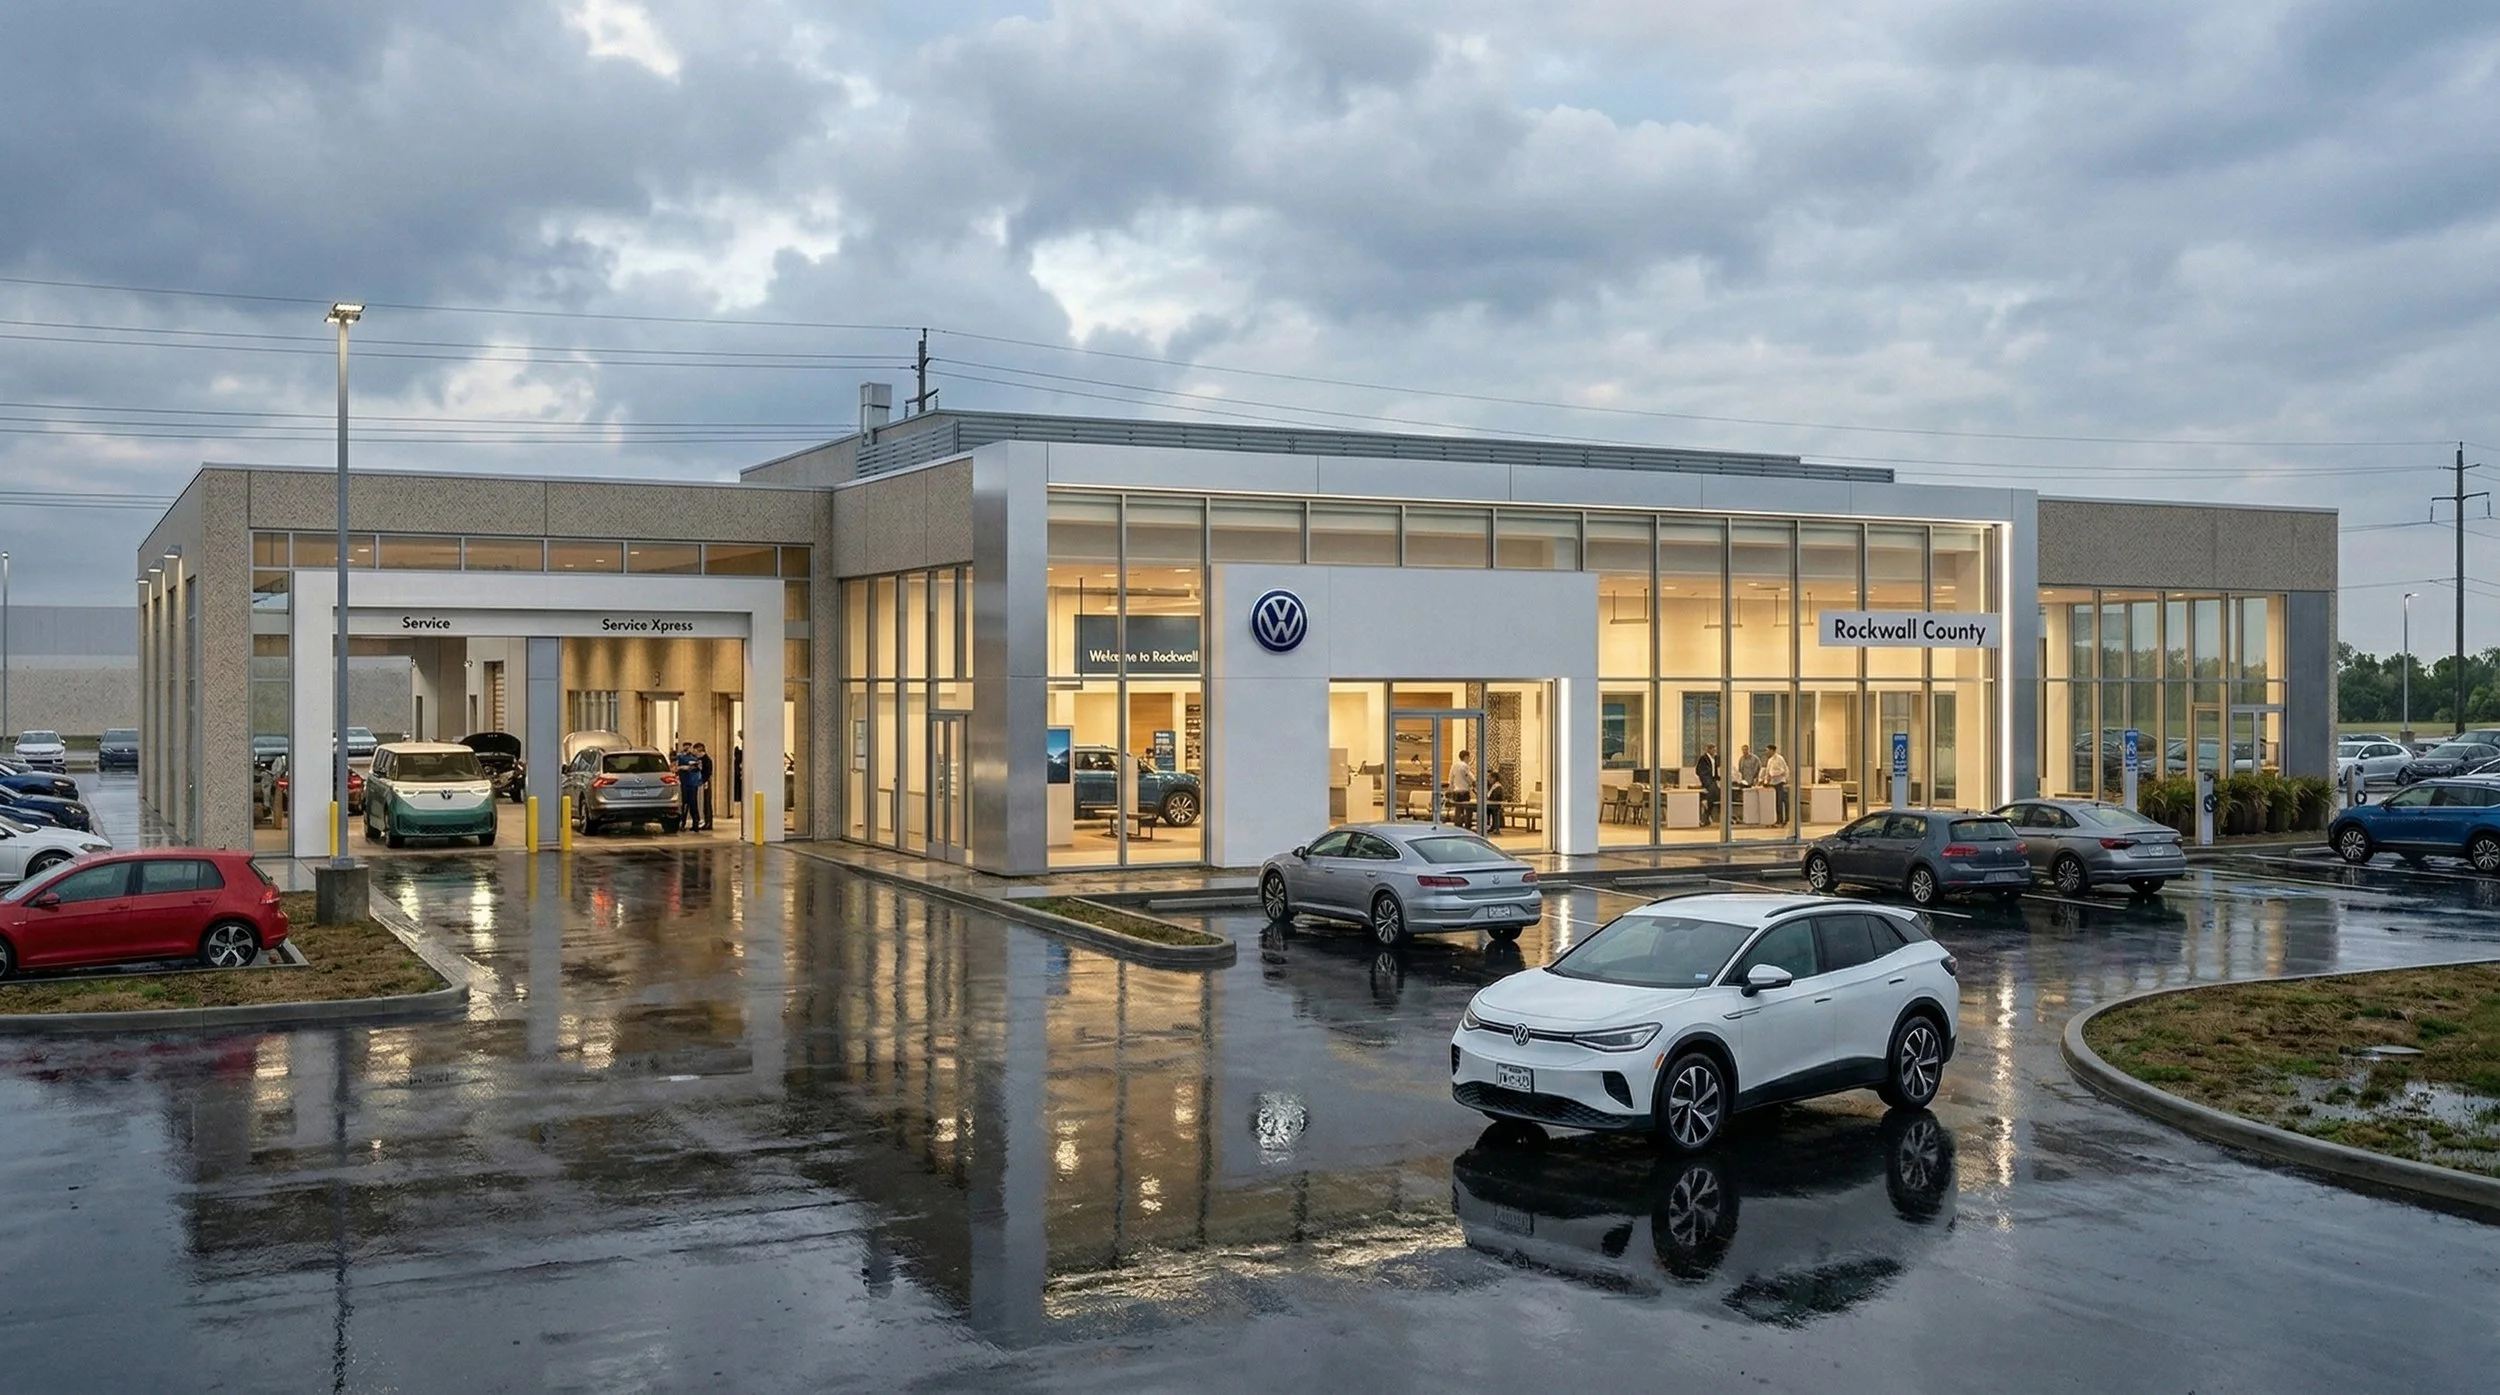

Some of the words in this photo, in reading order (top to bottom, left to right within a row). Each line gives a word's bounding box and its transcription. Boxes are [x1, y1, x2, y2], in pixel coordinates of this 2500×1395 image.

[402, 616, 450, 629] Service
[602, 618, 648, 631] Service
[651, 619, 693, 634] Xpress
[1834, 617, 1917, 640] Rockwall
[1923, 619, 1986, 646] County
[1139, 651, 1150, 662] to
[1152, 649, 1199, 662] Rockwall
